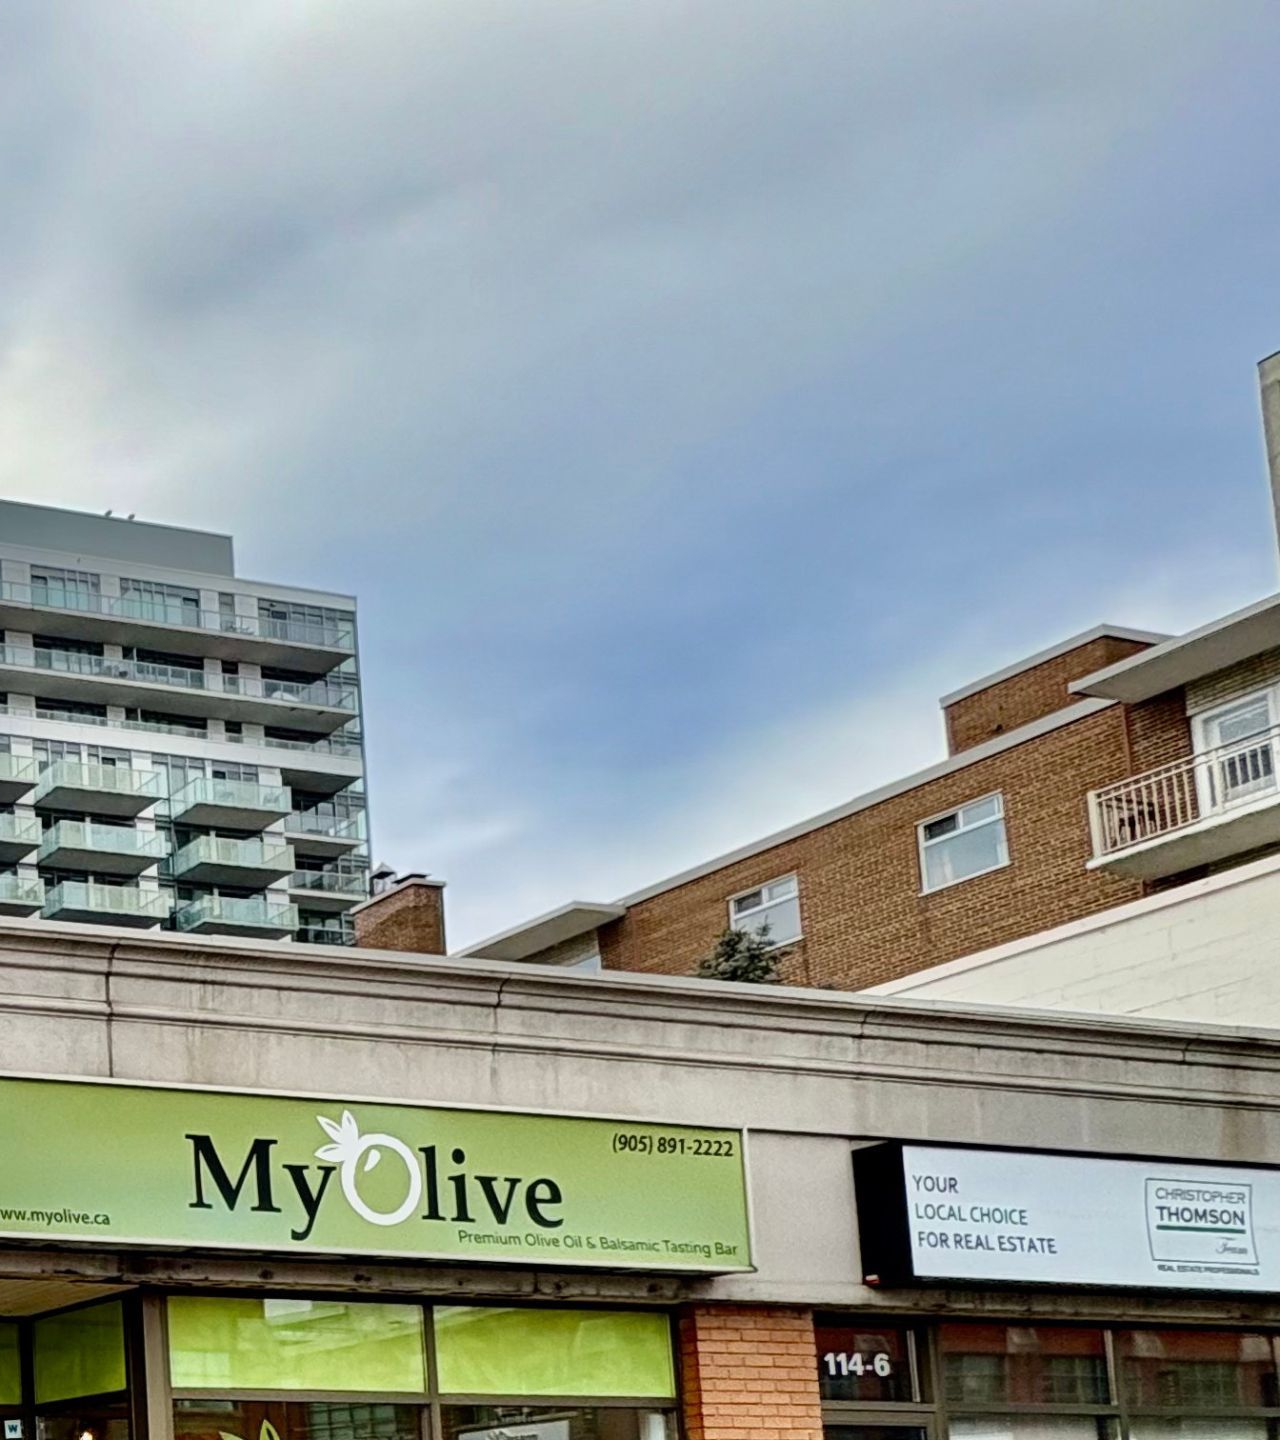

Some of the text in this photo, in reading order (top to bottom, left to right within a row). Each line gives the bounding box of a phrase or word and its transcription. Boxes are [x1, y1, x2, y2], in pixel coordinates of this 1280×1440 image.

[612, 1133, 734, 1157] (905) 891-2222
[912, 1175, 959, 1193] YOUR
[1155, 1187, 1246, 1204] CHRISTOPHER
[915, 1203, 1028, 1225] LOCAL CHOICE
[1155, 1206, 1246, 1225] THOMSON
[458, 1230, 738, 1258] Premium Olive Oil & Balsamic Tasting Bar
[918, 1231, 1058, 1254] FOR REAL ESTATE
[823, 1351, 891, 1377] 114-6
